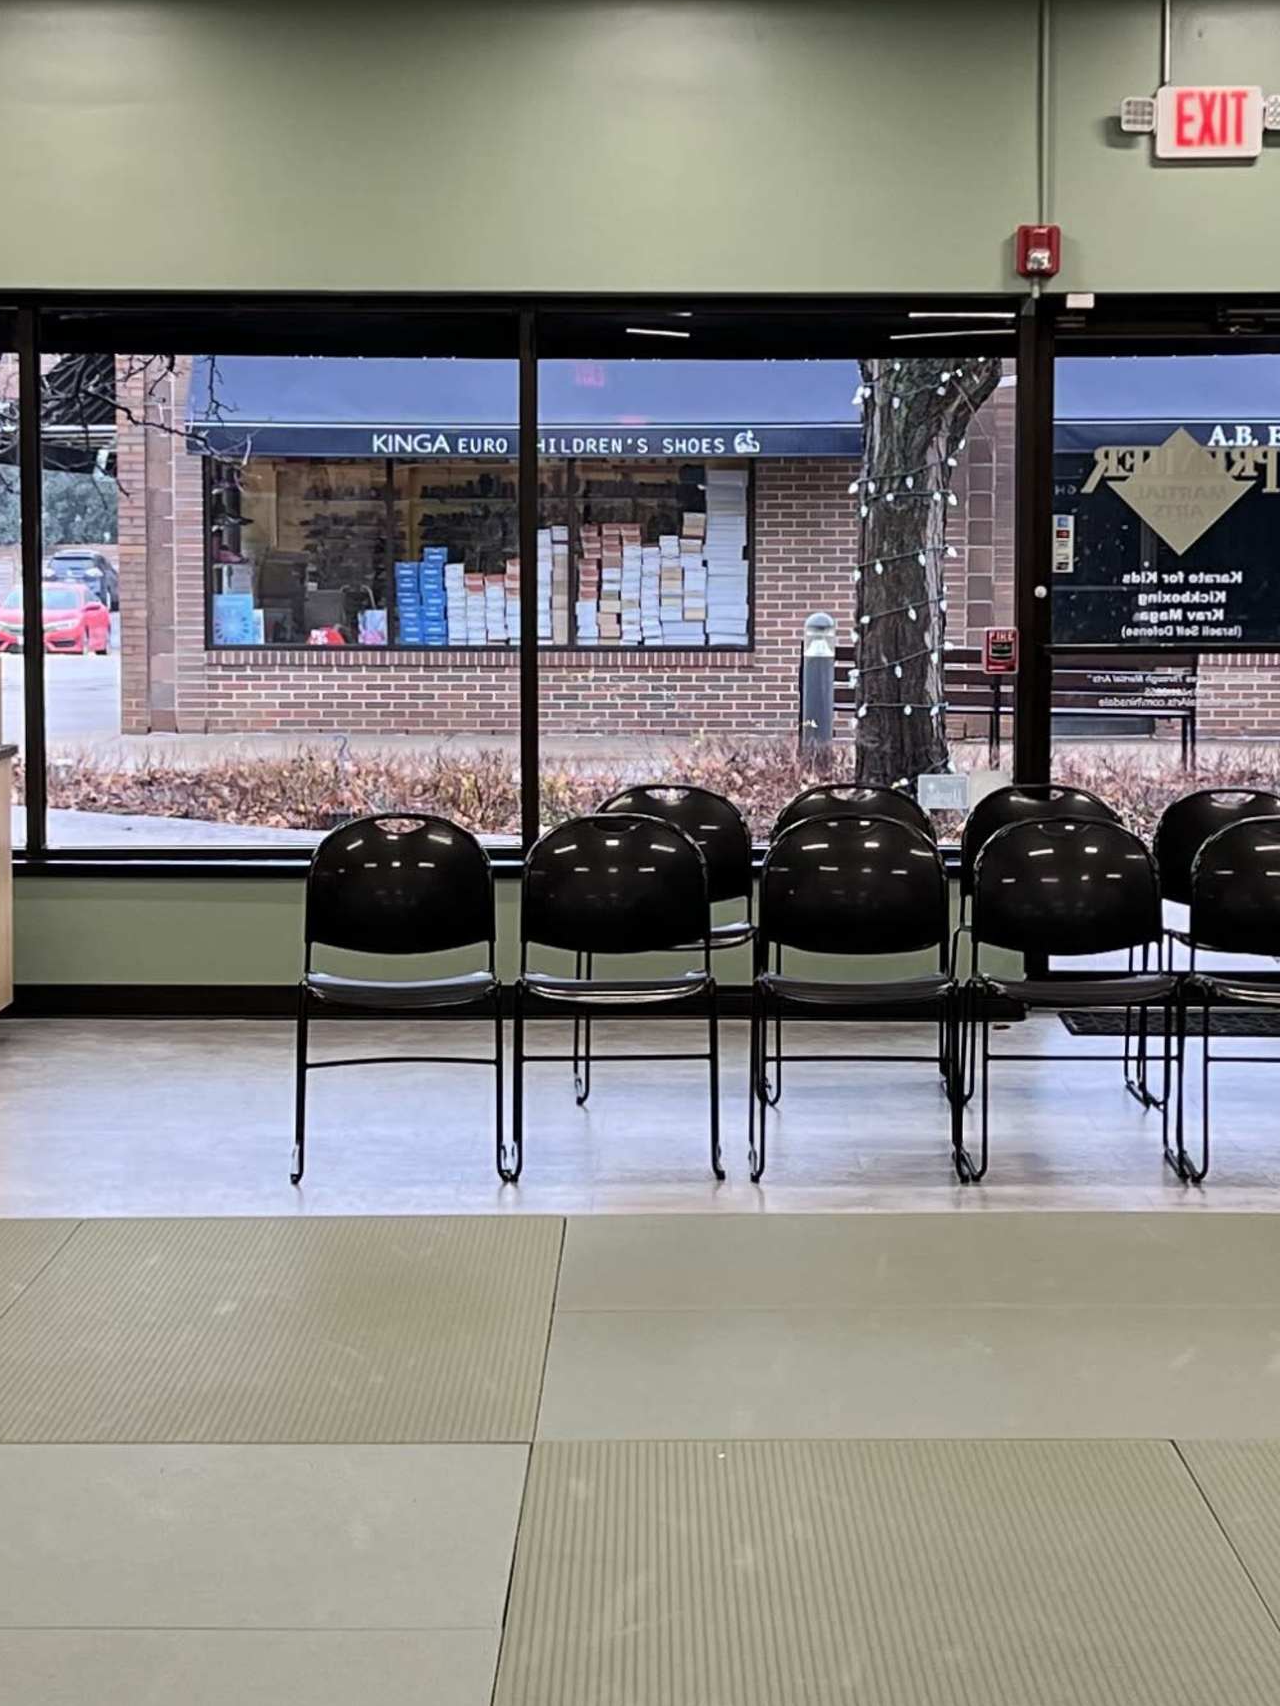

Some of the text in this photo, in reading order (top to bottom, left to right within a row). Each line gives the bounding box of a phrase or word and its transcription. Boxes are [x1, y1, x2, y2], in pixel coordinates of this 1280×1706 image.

[1175, 89, 1249, 147] EXIT
[372, 433, 725, 454] KINGA EURO HILDREN'S SHOES
[1208, 425, 1259, 447] A.B.
